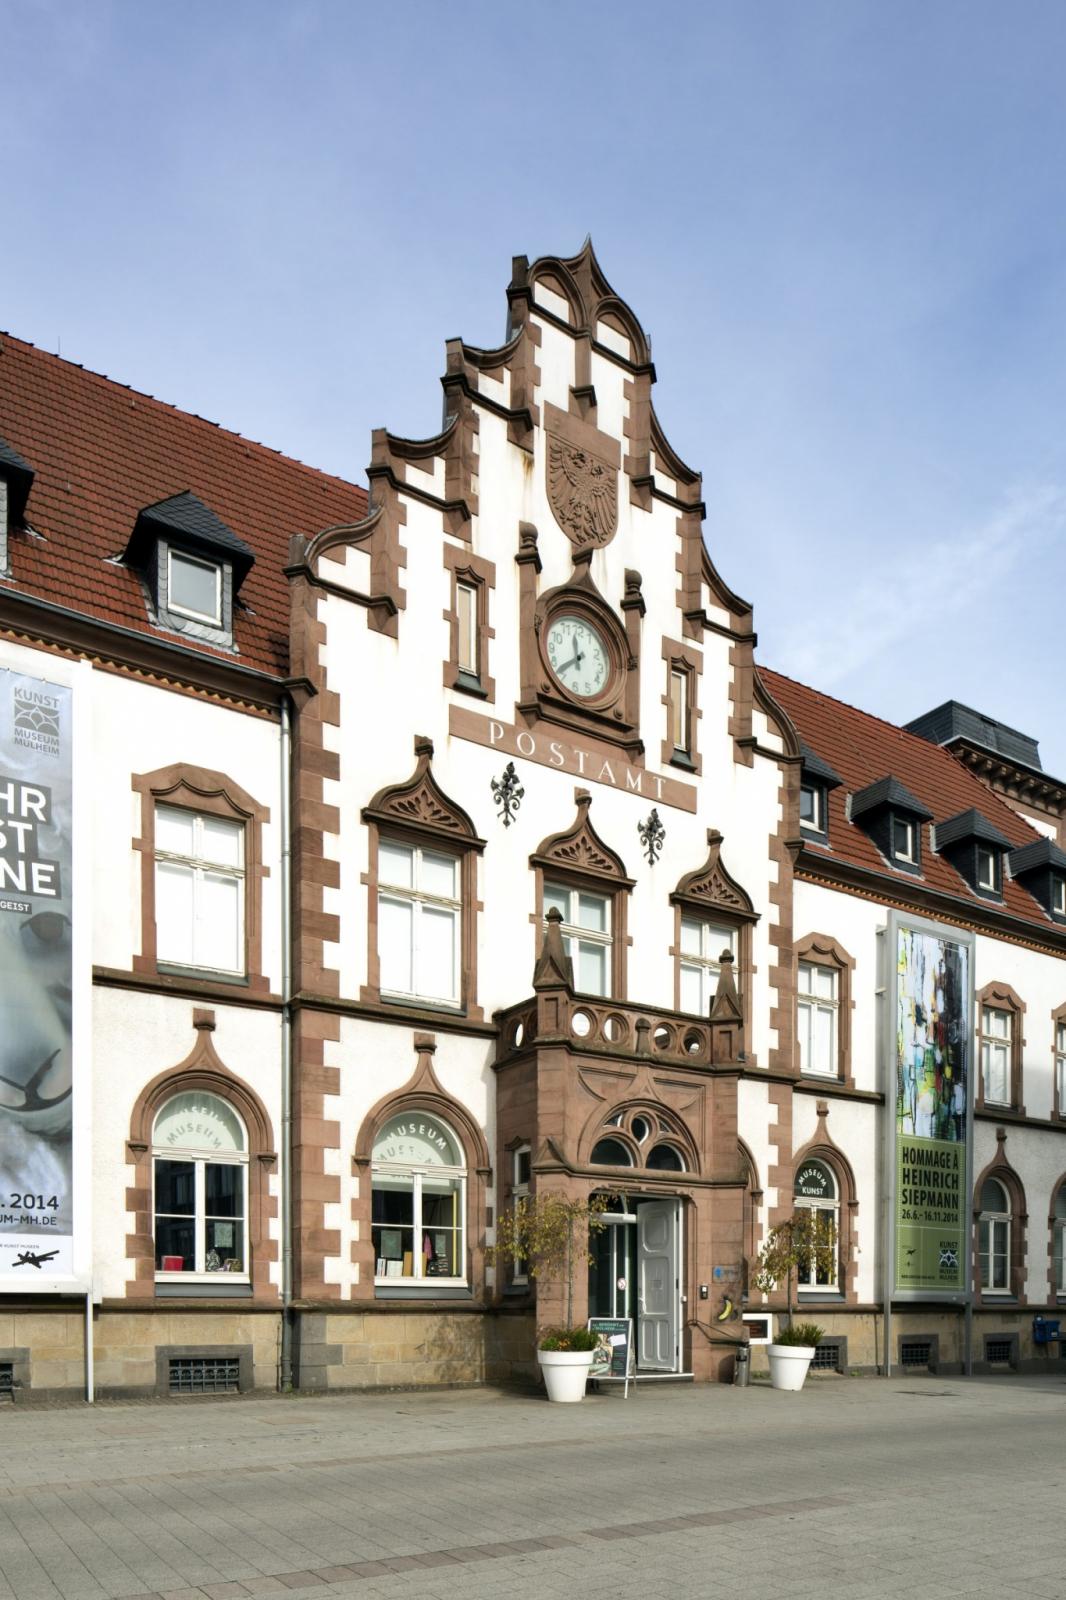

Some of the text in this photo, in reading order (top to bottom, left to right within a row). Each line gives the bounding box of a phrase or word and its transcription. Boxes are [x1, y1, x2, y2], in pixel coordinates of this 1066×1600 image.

[14, 687, 60, 709] KUNST
[14, 727, 60, 746] MUSEUM
[488, 722, 666, 799] POSTAMT
[386, 1123, 447, 1150] MUSEUM
[902, 1146, 951, 1169] HOMMAGE
[798, 1168, 827, 1187] MUSEUM
[902, 1167, 959, 1190] HEINRICH
[802, 1187, 824, 1195] KUNST
[902, 1188, 959, 1210] SIEPMANN
